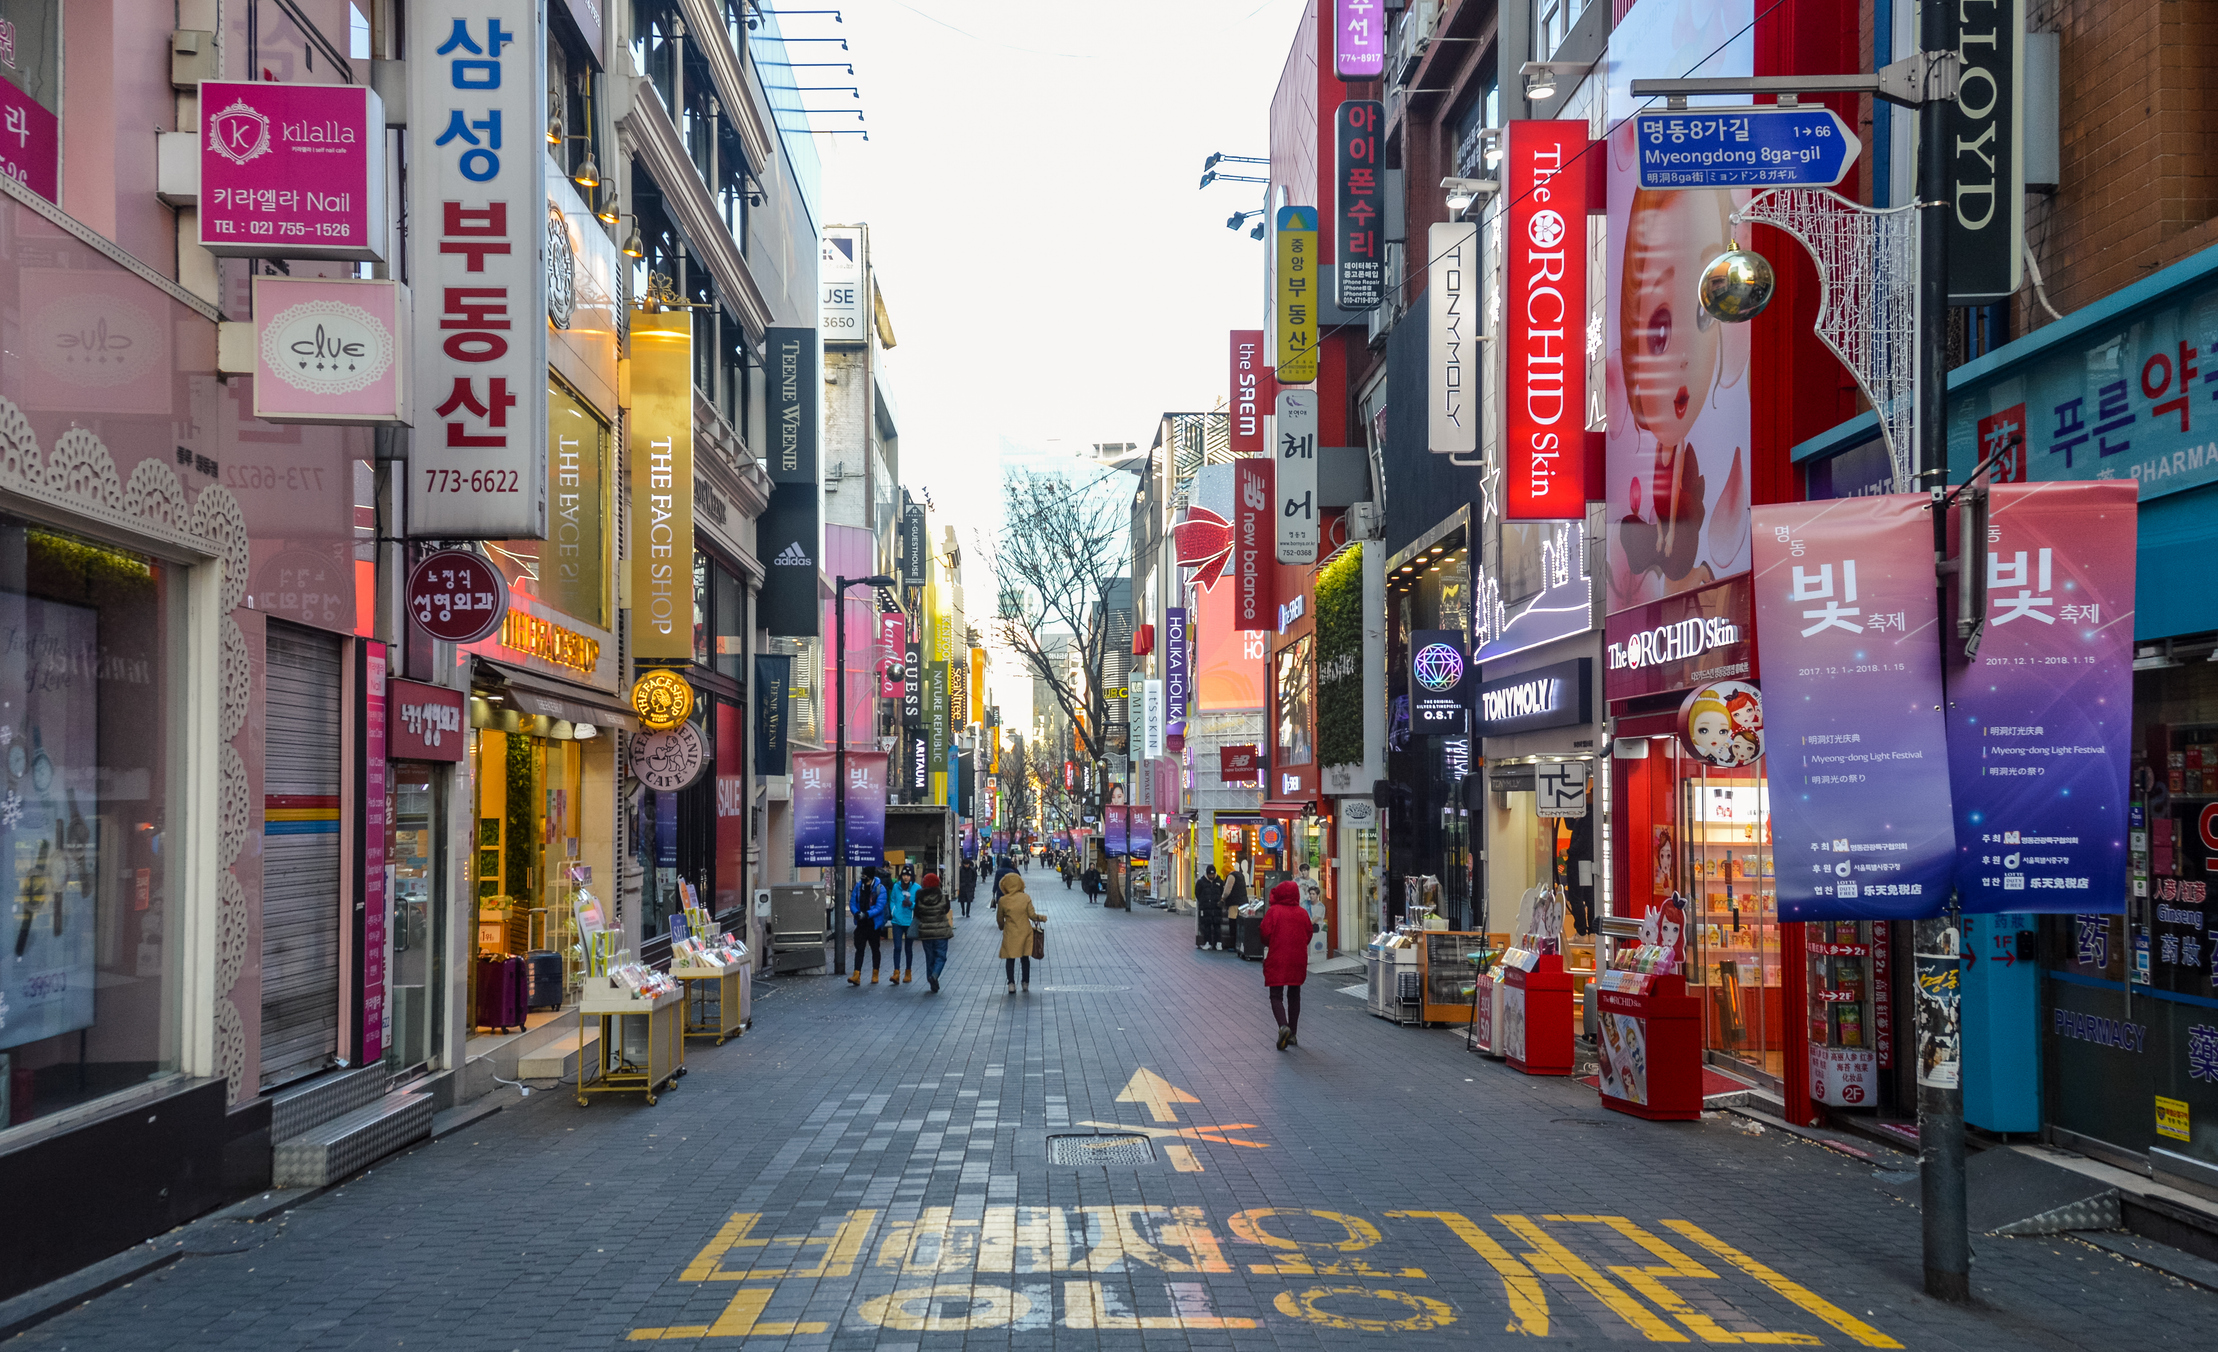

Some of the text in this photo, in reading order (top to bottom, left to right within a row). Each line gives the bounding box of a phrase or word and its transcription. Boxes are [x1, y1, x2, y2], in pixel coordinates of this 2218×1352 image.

[1340, 53, 1381, 62] 774-8917
[282, 120, 355, 143] kilalla
[1643, 118, 1750, 144] 명동8가길
[1793, 126, 1831, 138] 1 66
[1646, 146, 1820, 166] Myeongdong 8ga-gil
[1347, 105, 1377, 257] 아이폰수리
[1647, 170, 1797, 184] 明洞8ga街 ミョンドン8ガギル
[214, 188, 350, 212] 키라엘라 Nail
[214, 220, 350, 237] TEL 02) 755-1526
[1287, 238, 1307, 352] 중앙부동산
[823, 317, 855, 328] 3650
[1527, 142, 1565, 498] The ORCHID Skin
[1446, 246, 1461, 428] TONYMOLY
[1239, 343, 1255, 370] the
[782, 340, 800, 471] TEENIE WEENIE
[425, 468, 519, 493] 773-6622
[651, 436, 672, 634] THE FACE SHOP
[1244, 512, 1255, 547] new
[911, 518, 920, 577] K-GUESTHOUSE
[1774, 525, 1806, 557] 명동
[774, 556, 811, 567] adidas
[427, 570, 471, 589] 노정식
[1244, 550, 1258, 620] balance
[1987, 547, 2056, 627] 빛
[413, 592, 494, 623] 성형외과
[1791, 559, 1864, 638] 빛
[1867, 611, 1906, 633] 축제
[2059, 603, 2100, 624] 축제
[1170, 617, 1182, 669] HOLIKA
[1244, 642, 1264, 660] HO
[1608, 644, 1628, 670] The
[1627, 617, 1705, 670] ORCHID
[1705, 617, 1735, 649] Skin
[1799, 667, 1821, 676] 2017.
[1824, 667, 1838, 675] 12.
[1855, 664, 1880, 673] 2018.
[1894, 662, 1905, 671] 15
[1986, 657, 2010, 666] 2017.
[2014, 657, 2027, 665] 12.
[2045, 656, 2069, 665] 2018.
[2083, 656, 2095, 664] 15
[905, 651, 918, 716] GUESS
[1170, 673, 1182, 725] HOLIKA
[1482, 678, 1555, 721] TONYMOLY
[933, 670, 942, 763] NATURE REPUBLIC
[1132, 696, 1141, 752] MISSHA
[1423, 711, 1454, 720] O.S.T
[1808, 733, 1861, 745] 明洞灯光庆典
[1990, 726, 2044, 737] 明洞灯光庆典
[1811, 750, 1922, 764] Myeong-dong Light Festival
[1991, 745, 2105, 756] Myeong-dong Light Festival
[915, 738, 925, 788] ARITAUM
[1989, 766, 2045, 777] 明洞光の祭り
[646, 771, 685, 787] CAFE
[802, 768, 820, 790] 빛
[851, 768, 868, 789] 빛
[1811, 773, 1866, 785] 明洞光の祭り
[718, 779, 740, 817] SALE
[1863, 884, 1922, 897] 乐天免税店
[2030, 877, 2089, 889] 乐天免税店
[2157, 903, 2203, 930] Ginseng
[673, 925, 687, 943] SALE
[1994, 935, 2013, 948] 1F
[1854, 947, 1866, 955] 2F
[2054, 1008, 2147, 1053] PHARMACY
[1845, 1087, 1862, 1100] 2F
